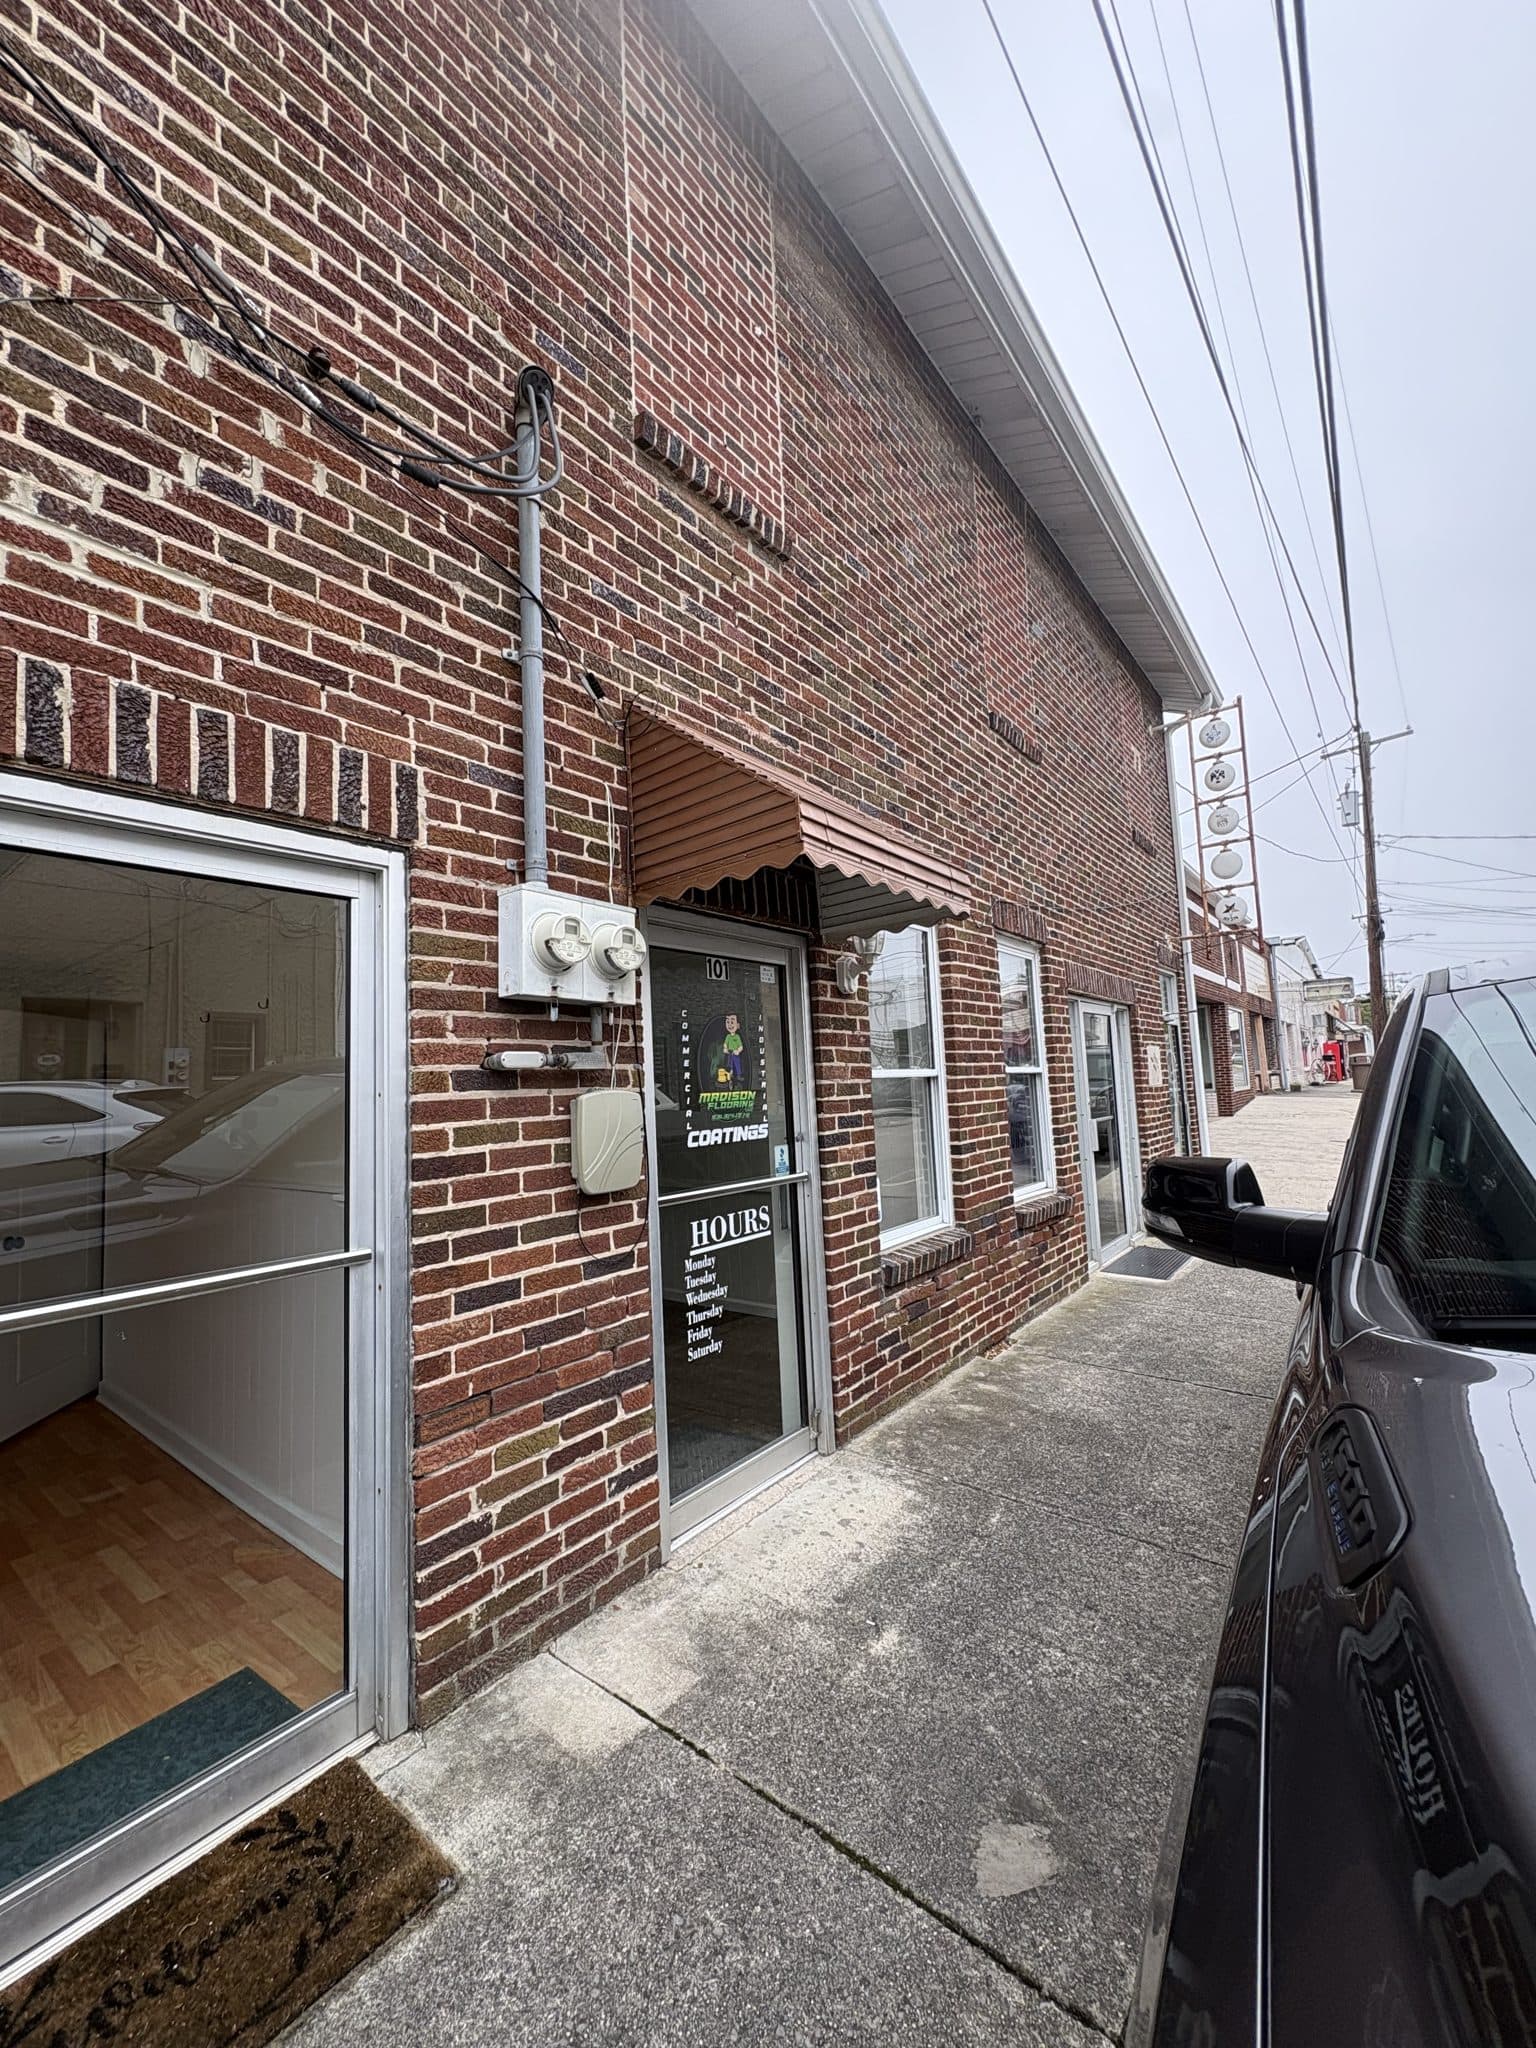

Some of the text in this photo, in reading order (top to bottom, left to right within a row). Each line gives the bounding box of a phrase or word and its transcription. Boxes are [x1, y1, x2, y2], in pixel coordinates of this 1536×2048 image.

[706, 957, 729, 980] 101
[681, 1009, 693, 1130] COMMERCIAL
[758, 1013, 769, 1122] INDUSTRIAL
[699, 1090, 757, 1104] MADISON
[707, 1100, 754, 1110] FLOORING
[687, 1123, 769, 1148] COATINGS
[690, 1205, 770, 1248] HOURS
[684, 1254, 716, 1273] Monday
[684, 1270, 717, 1290] Tuesday
[685, 1284, 729, 1306] Wednesday
[686, 1303, 724, 1326] Thursday
[687, 1325, 713, 1344] Friday
[687, 1338, 723, 1362] Saturday
